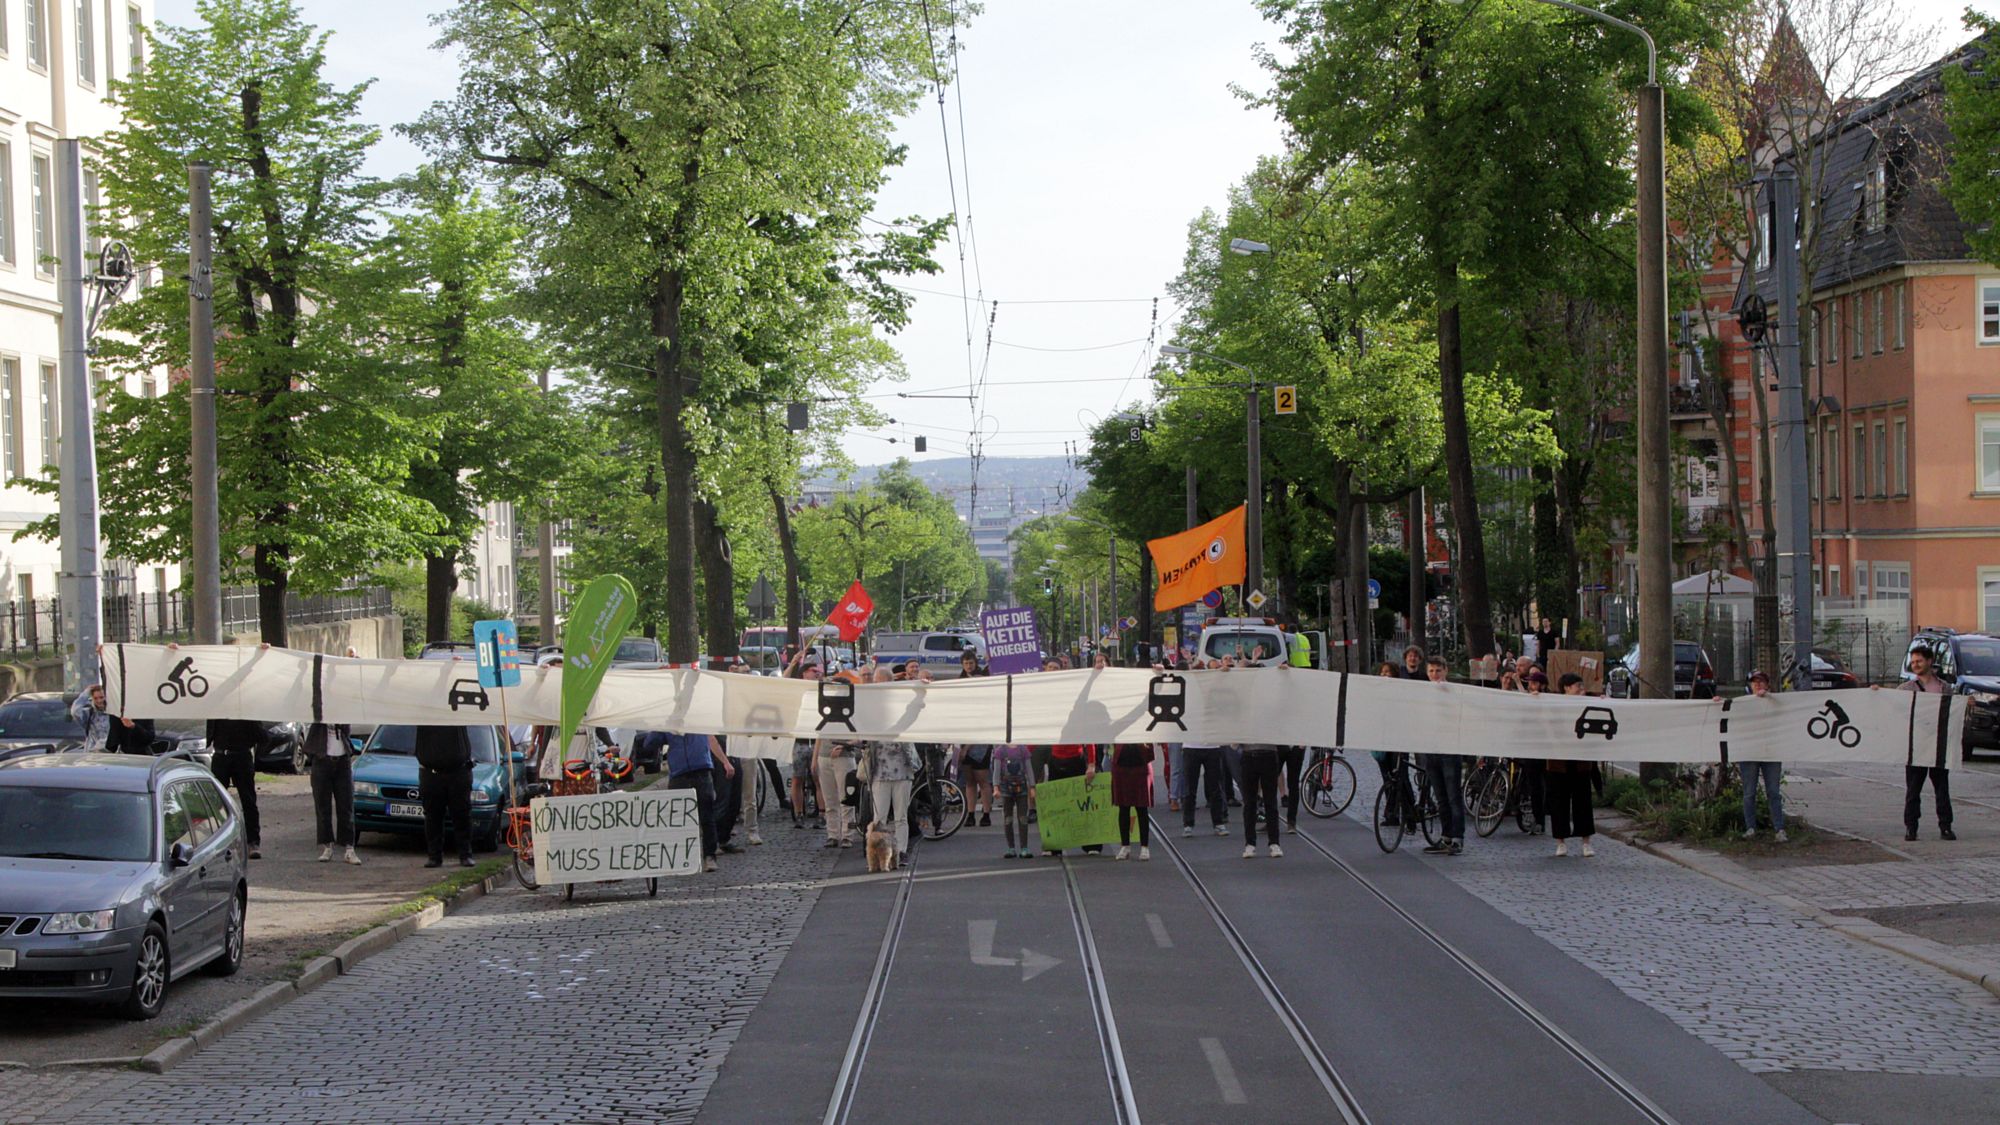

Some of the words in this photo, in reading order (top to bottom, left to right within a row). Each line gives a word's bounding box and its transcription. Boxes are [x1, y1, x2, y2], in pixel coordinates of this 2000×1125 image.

[1280, 392, 1291, 408] 2
[1131, 429, 1139, 440] 3
[986, 613, 1009, 628] AUF
[1011, 611, 1032, 624] DIE
[986, 625, 1035, 645] KETTE
[989, 641, 1037, 657] KRIEGEN
[533, 797, 699, 834] KÖNIGSBRÜCKER
[546, 848, 600, 871] MUSS
